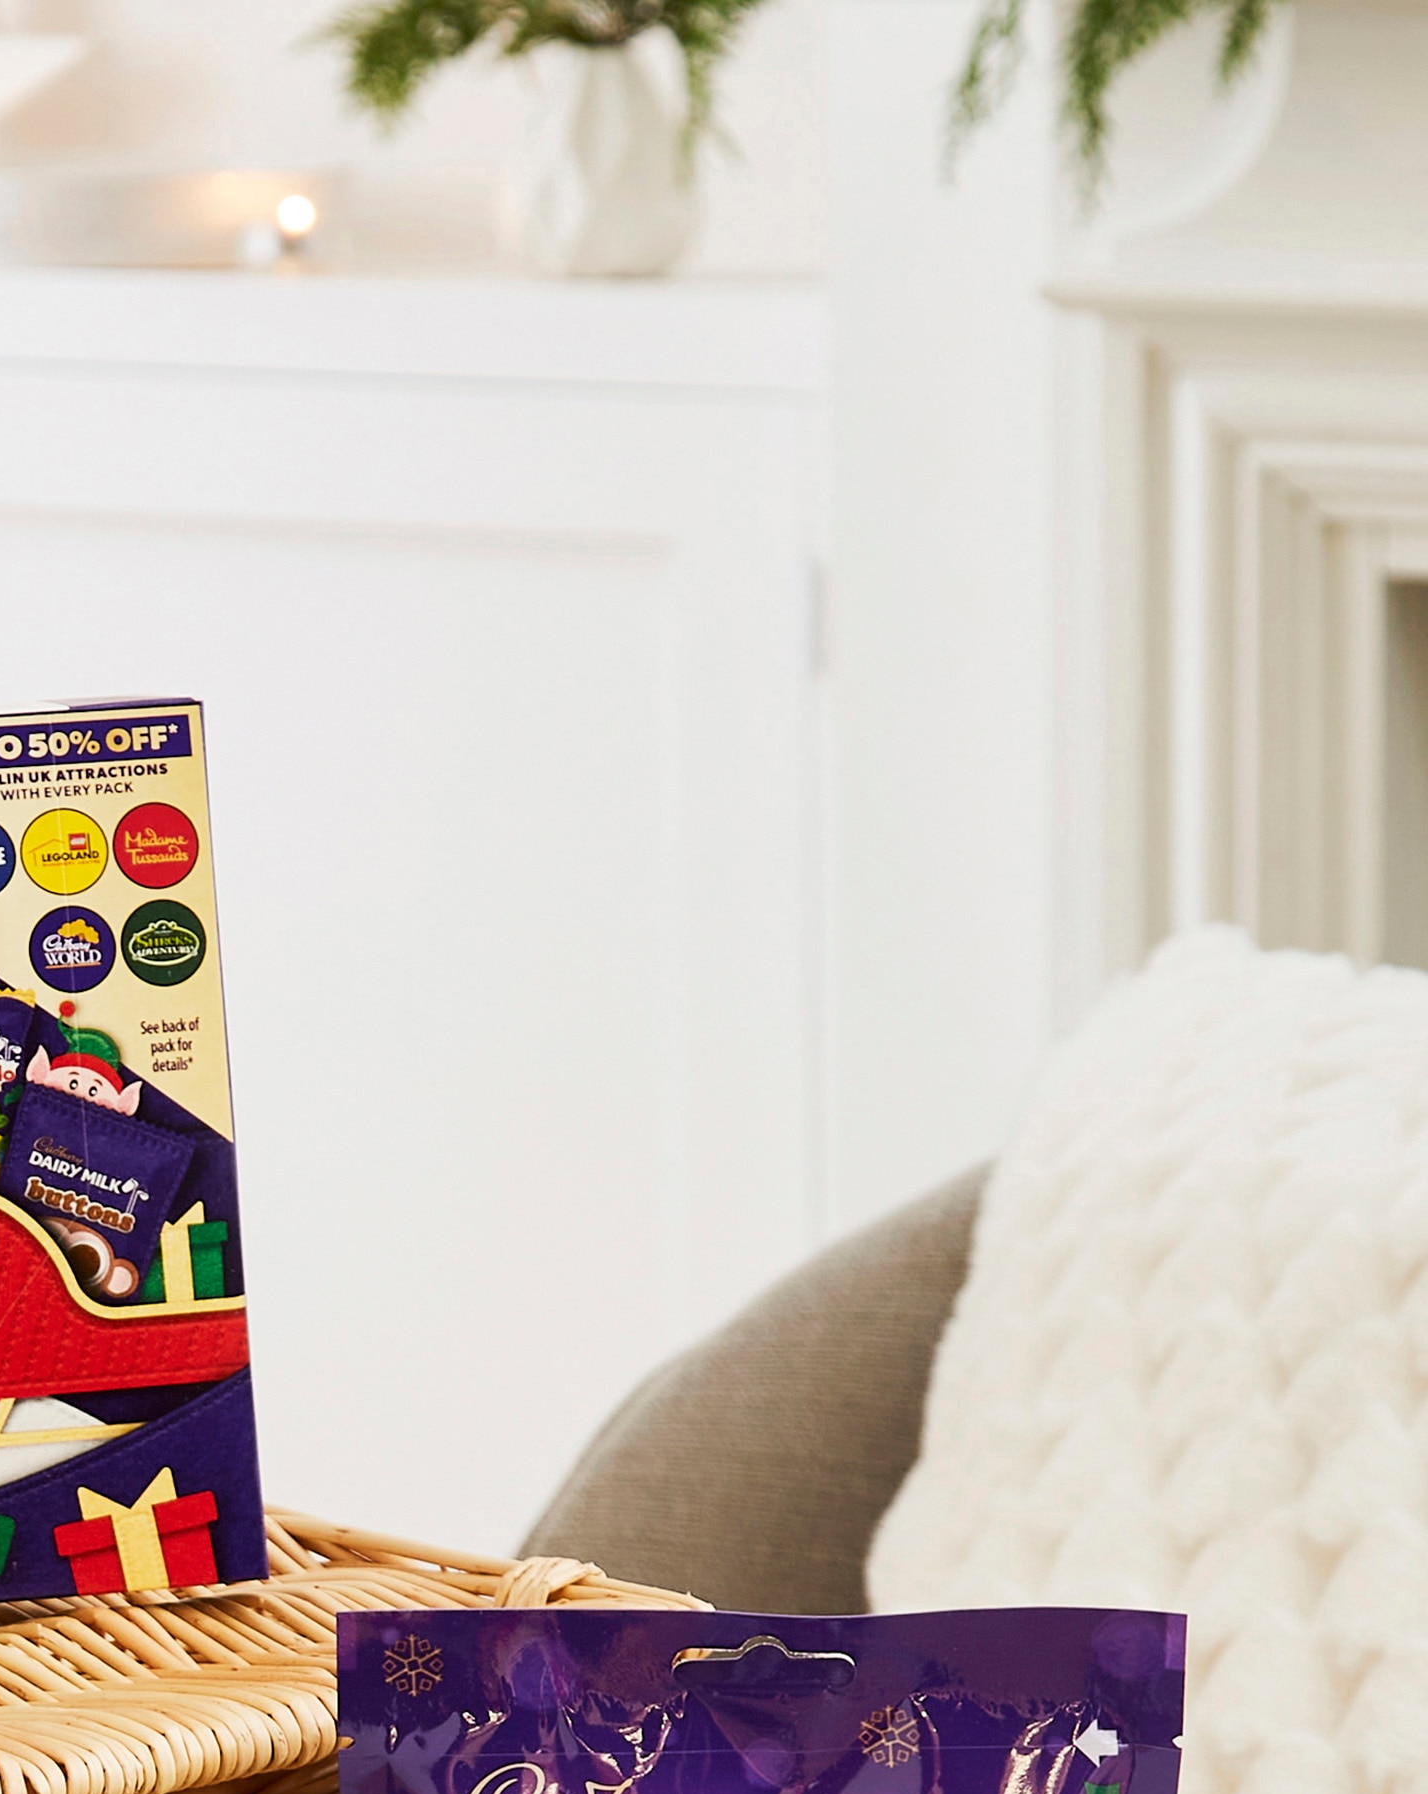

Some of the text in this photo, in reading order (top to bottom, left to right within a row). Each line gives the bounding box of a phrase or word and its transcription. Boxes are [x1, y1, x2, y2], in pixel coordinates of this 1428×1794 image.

[28, 730, 101, 758] 50%
[28, 770, 50, 783] UK
[56, 763, 168, 781] ATTRACTIONS
[0, 781, 134, 801] WITH EVERY PACK
[125, 828, 188, 848] Madame
[42, 849, 100, 863] LEGOLAND
[125, 845, 189, 865] Tussauds
[44, 948, 102, 965] WORLD
[140, 1017, 200, 1036] See back of
[150, 1038, 192, 1056] pack for
[29, 1151, 122, 1195] DAIRY MILK
[24, 1177, 135, 1233] buttons
